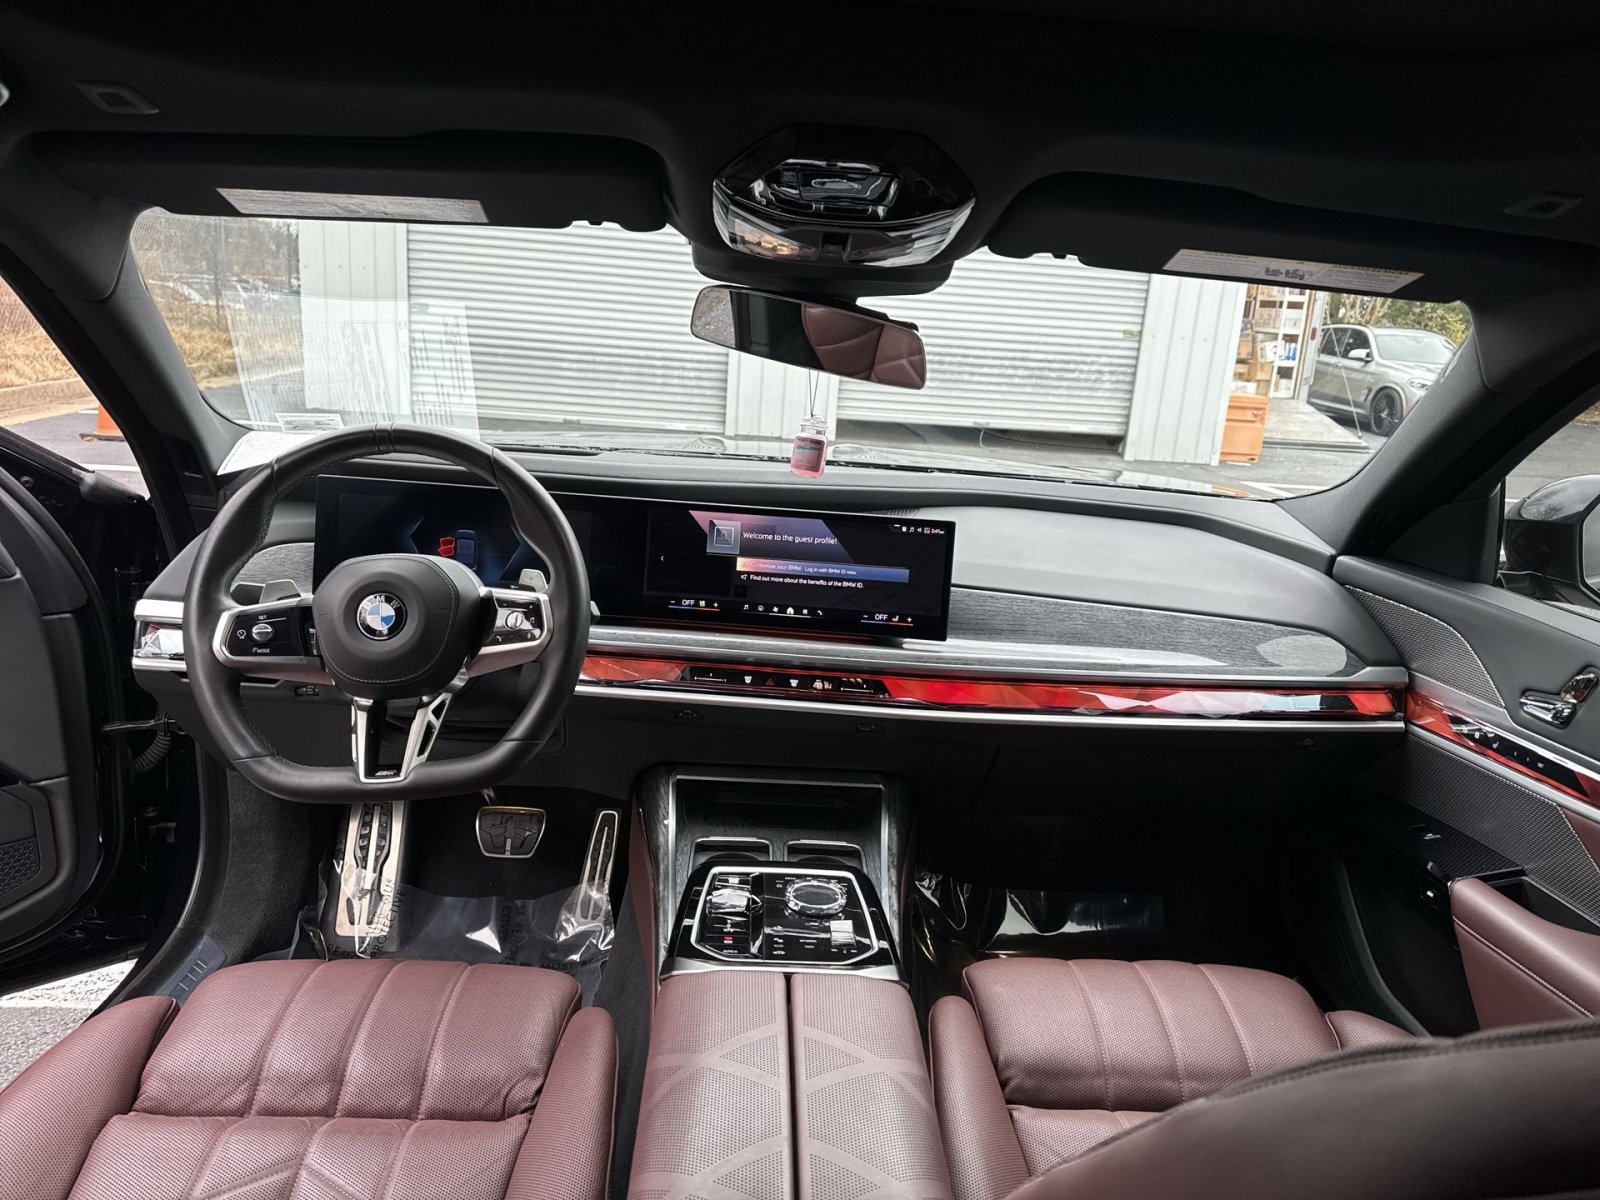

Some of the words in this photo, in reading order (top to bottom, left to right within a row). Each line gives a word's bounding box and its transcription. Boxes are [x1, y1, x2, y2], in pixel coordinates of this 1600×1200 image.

[742, 532, 773, 540] Welcome
[814, 537, 838, 545] profile!
[362, 595, 401, 610] BMW
[874, 613, 888, 621] OFF
